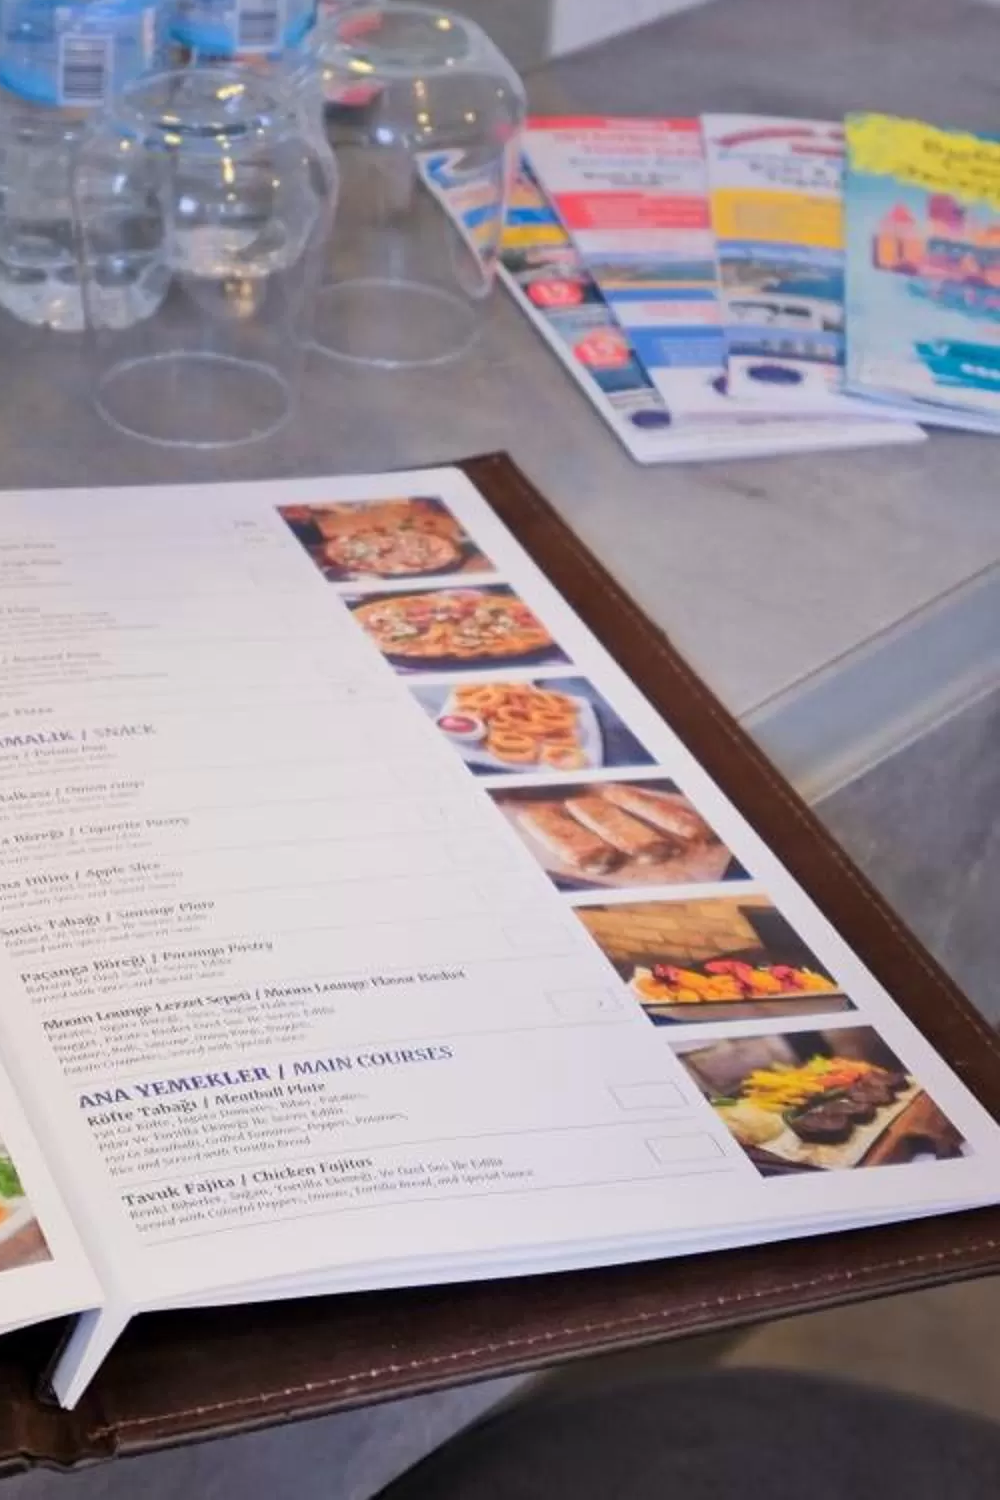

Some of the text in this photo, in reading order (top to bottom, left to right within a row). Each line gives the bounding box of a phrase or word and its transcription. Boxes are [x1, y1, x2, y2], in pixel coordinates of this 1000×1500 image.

[79, 1086, 132, 1109] ANA
[134, 1064, 270, 1100] YEMEKLER
[292, 1053, 352, 1078] MAIN
[356, 1041, 454, 1071] COURSES
[87, 1109, 132, 1128] Köfte
[121, 1185, 180, 1206] Tavuk
[184, 1176, 235, 1196] Fajita
[252, 1164, 315, 1185] Chicken
[318, 1155, 372, 1175] Fajitas
